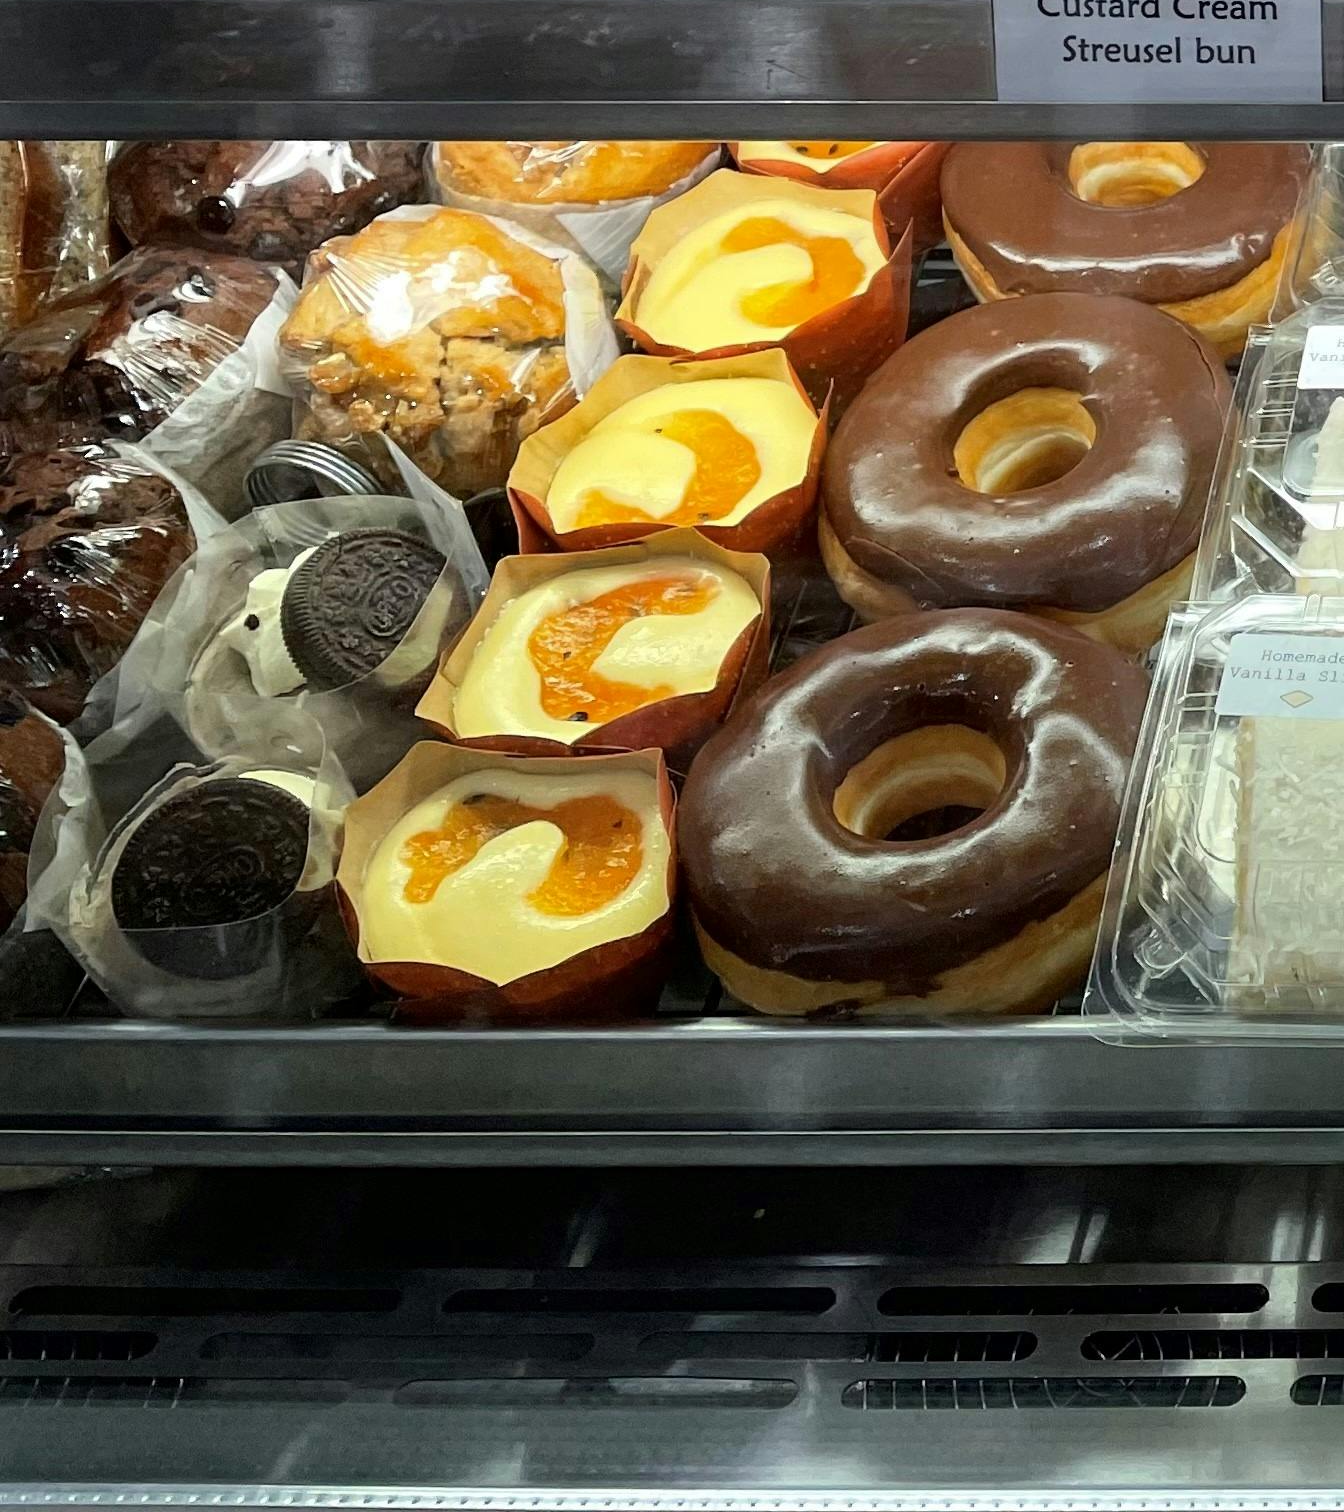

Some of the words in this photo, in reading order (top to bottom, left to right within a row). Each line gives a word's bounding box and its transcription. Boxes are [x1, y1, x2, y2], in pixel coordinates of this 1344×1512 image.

[1062, 35, 1181, 63] Streusel
[1195, 37, 1256, 64] bun
[1230, 666, 1306, 682] Vanilla
